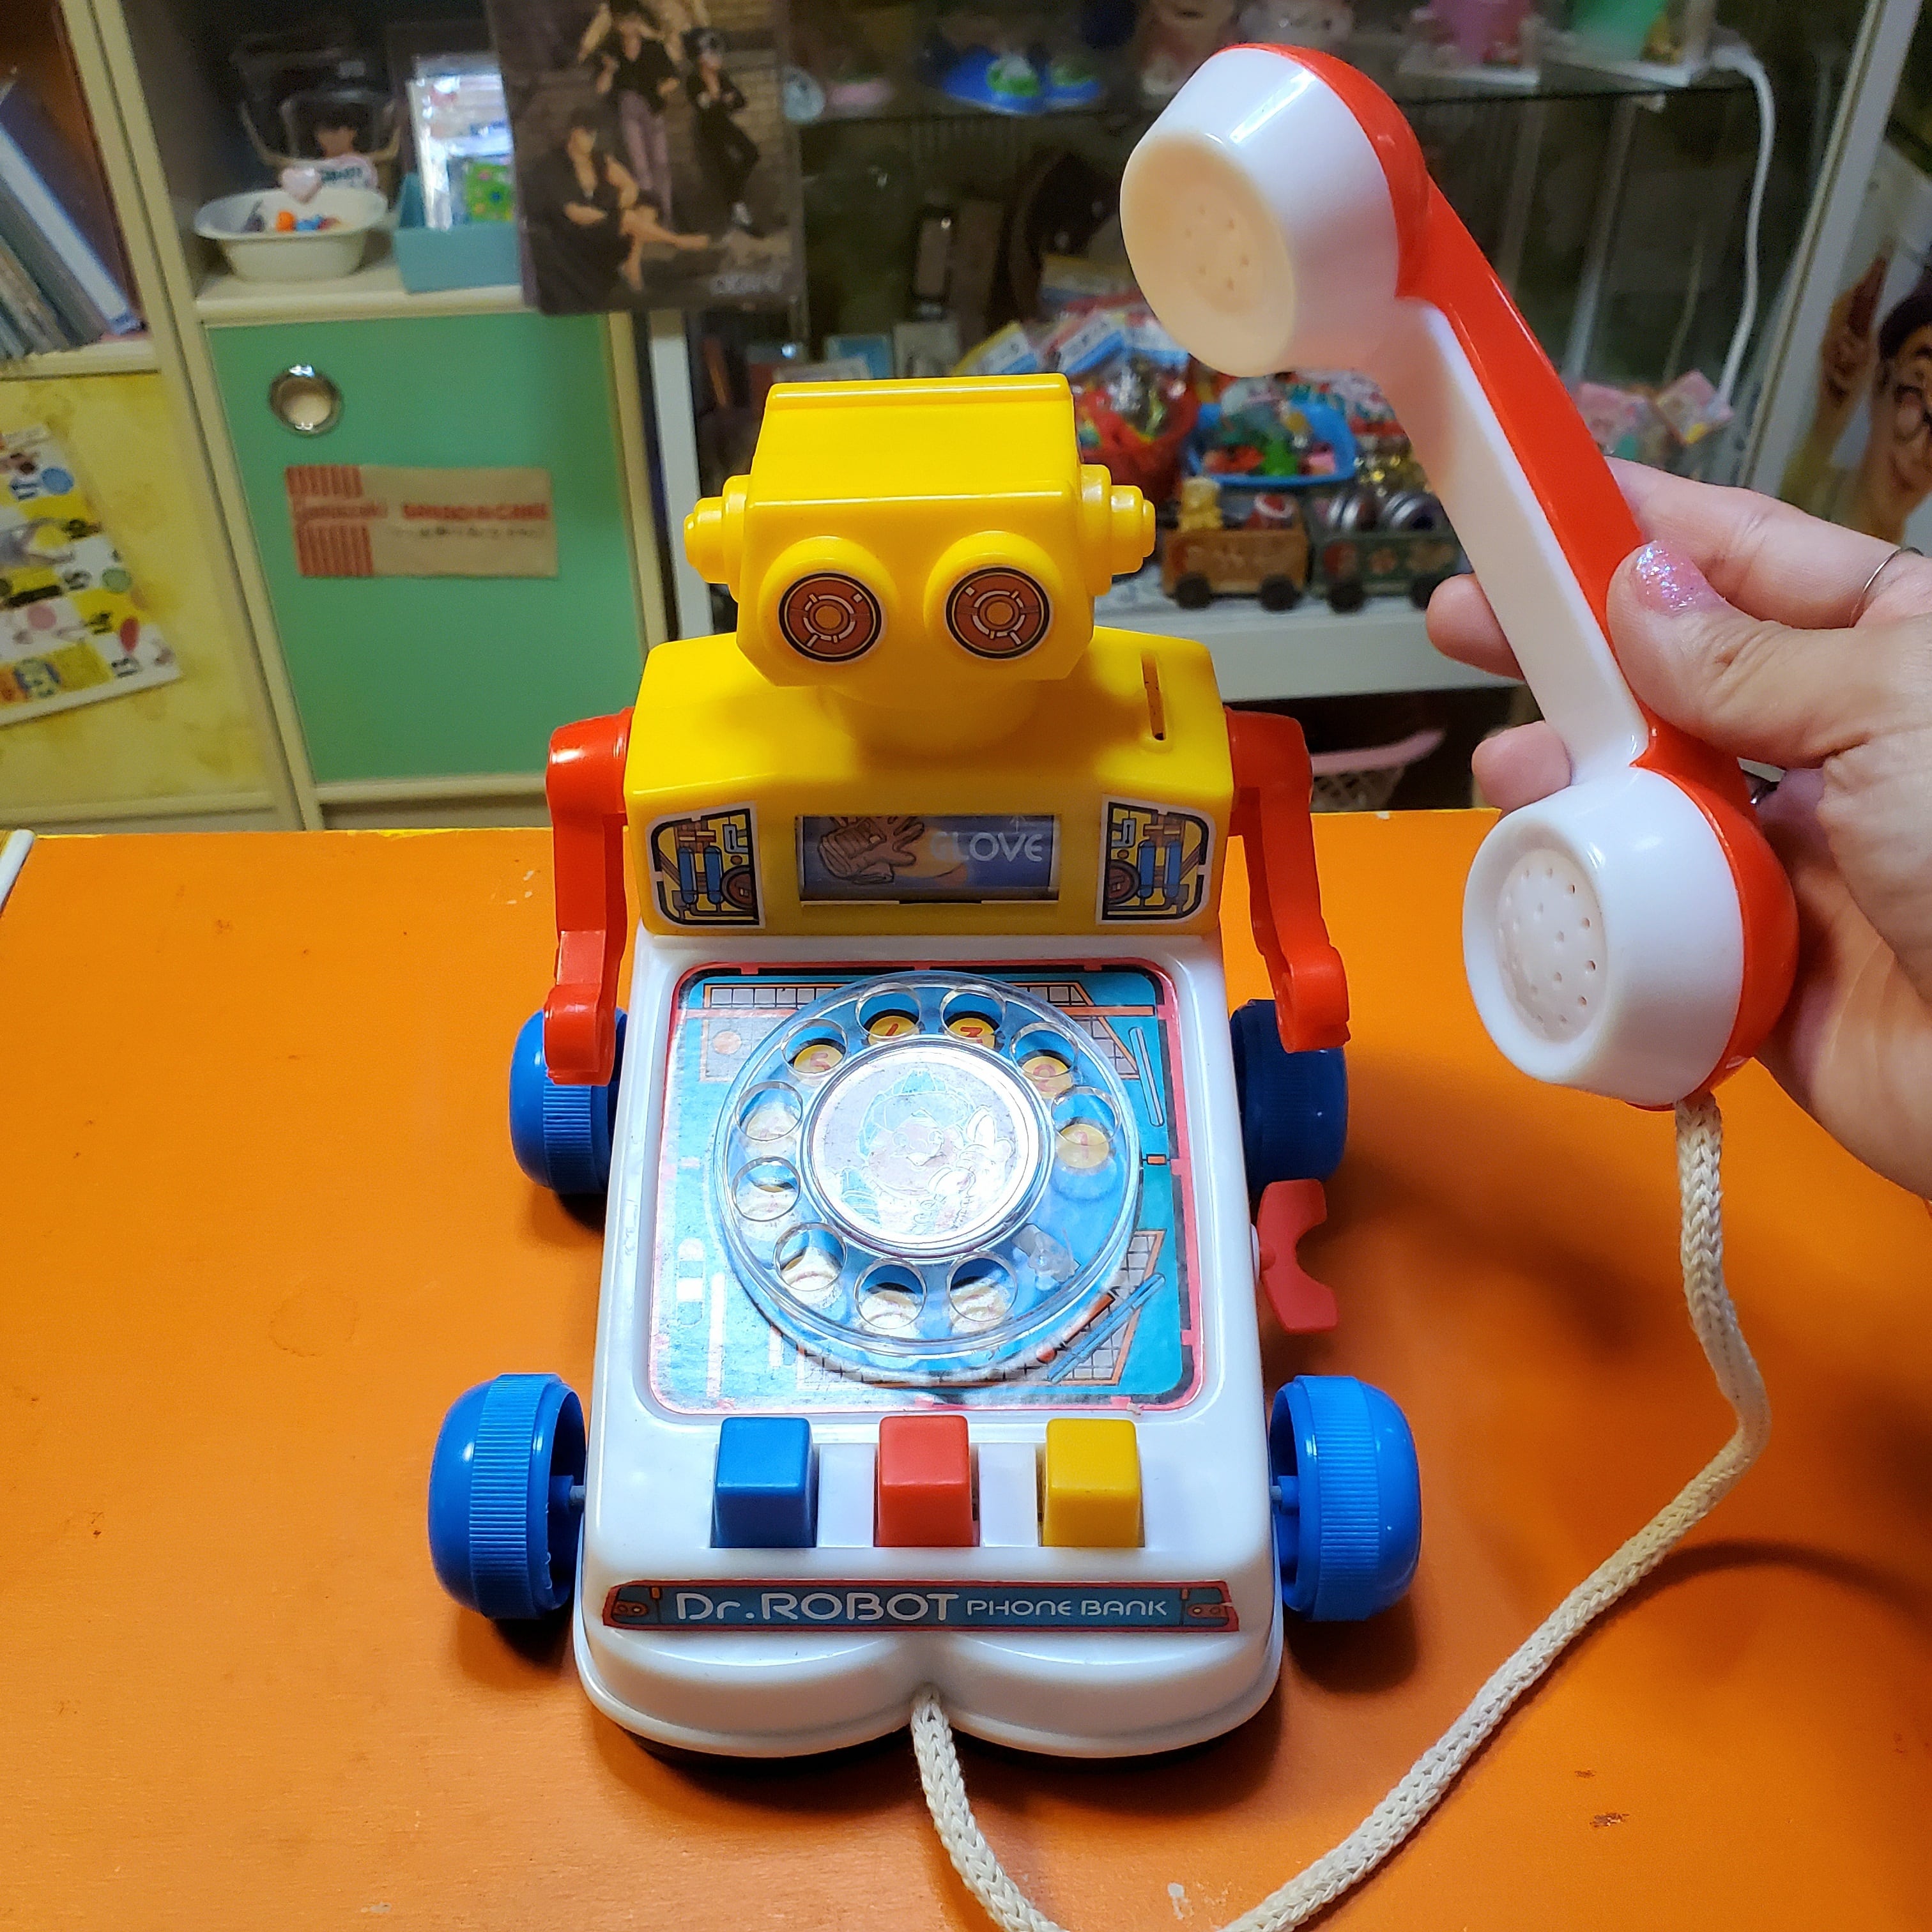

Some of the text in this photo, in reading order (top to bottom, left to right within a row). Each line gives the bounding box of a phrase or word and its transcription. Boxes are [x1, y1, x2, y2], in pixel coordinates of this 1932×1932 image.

[930, 832, 1043, 861] GLOVE
[967, 1600, 1072, 1616] PHONE
[1081, 1600, 1167, 1616] BANK
